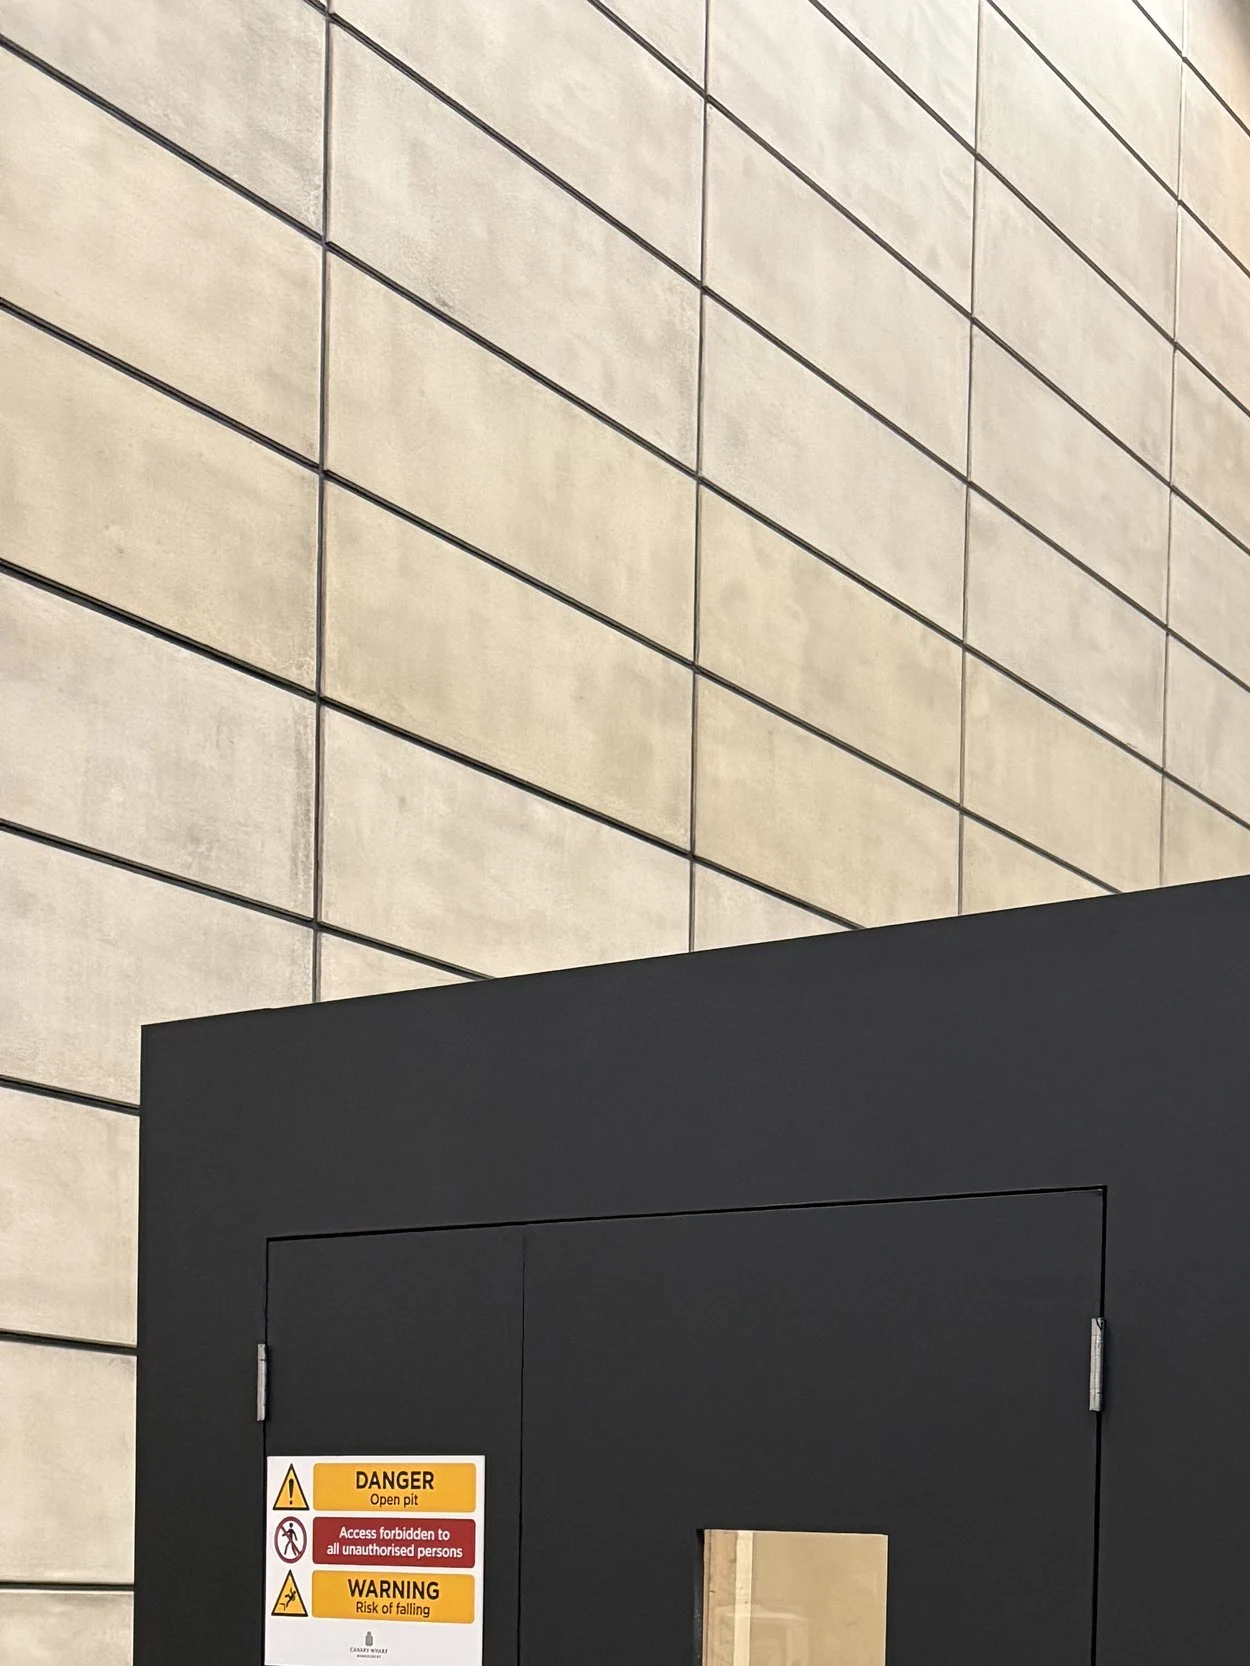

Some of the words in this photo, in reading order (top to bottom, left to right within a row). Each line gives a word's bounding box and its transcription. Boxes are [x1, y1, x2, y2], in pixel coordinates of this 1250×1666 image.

[355, 1470, 435, 1491] DANGER
[370, 1494, 400, 1508] Open
[402, 1494, 419, 1507] pit
[339, 1526, 377, 1541] Access
[379, 1526, 434, 1542] forbidden
[437, 1529, 451, 1542] to
[326, 1543, 340, 1556] all
[342, 1543, 415, 1558] unauthorised
[417, 1546, 464, 1561] persons
[348, 1578, 440, 1601] WARNING
[356, 1601, 379, 1615] Risk
[381, 1601, 393, 1616] of
[395, 1603, 431, 1618] falling
